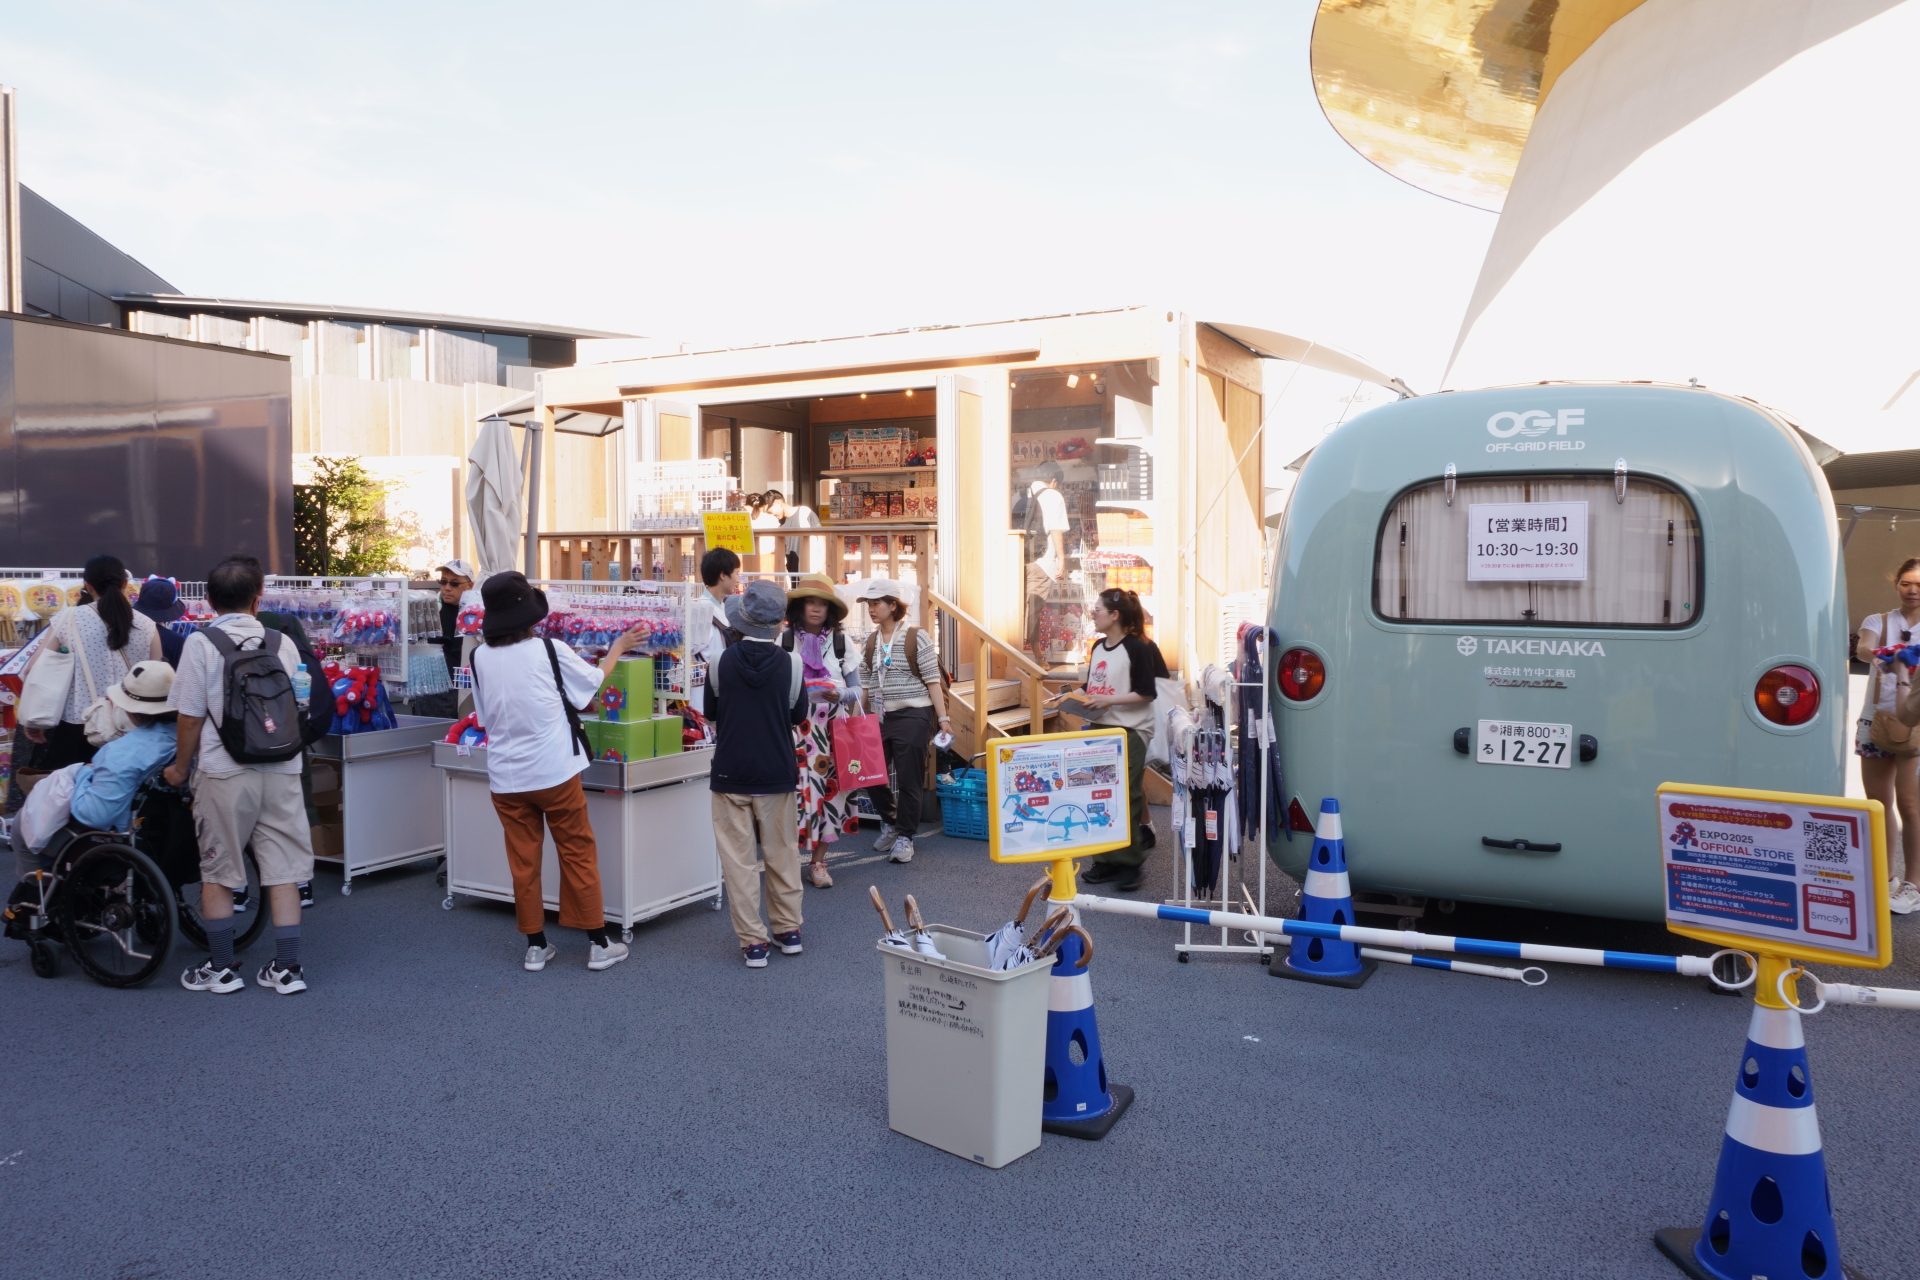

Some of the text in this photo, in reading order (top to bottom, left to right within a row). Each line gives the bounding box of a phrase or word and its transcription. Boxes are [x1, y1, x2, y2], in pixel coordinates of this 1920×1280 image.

[1487, 408, 1585, 438] OGF
[1485, 440, 1586, 453] OFF-GRID FIELD
[1488, 516, 1567, 533] 【営業時間】
[1483, 638, 1606, 657] TAKENAKA
[1484, 666, 1576, 678] 株式会社 竹中工務店
[1486, 676, 1568, 689] Roomette
[1500, 724, 1525, 738] 湘南
[1527, 726, 1550, 738] 800
[1482, 739, 1566, 765] る 12-27
[1700, 842, 1795, 862] OFFICIAL STORE
[1811, 911, 1849, 925] 5mc9y1
